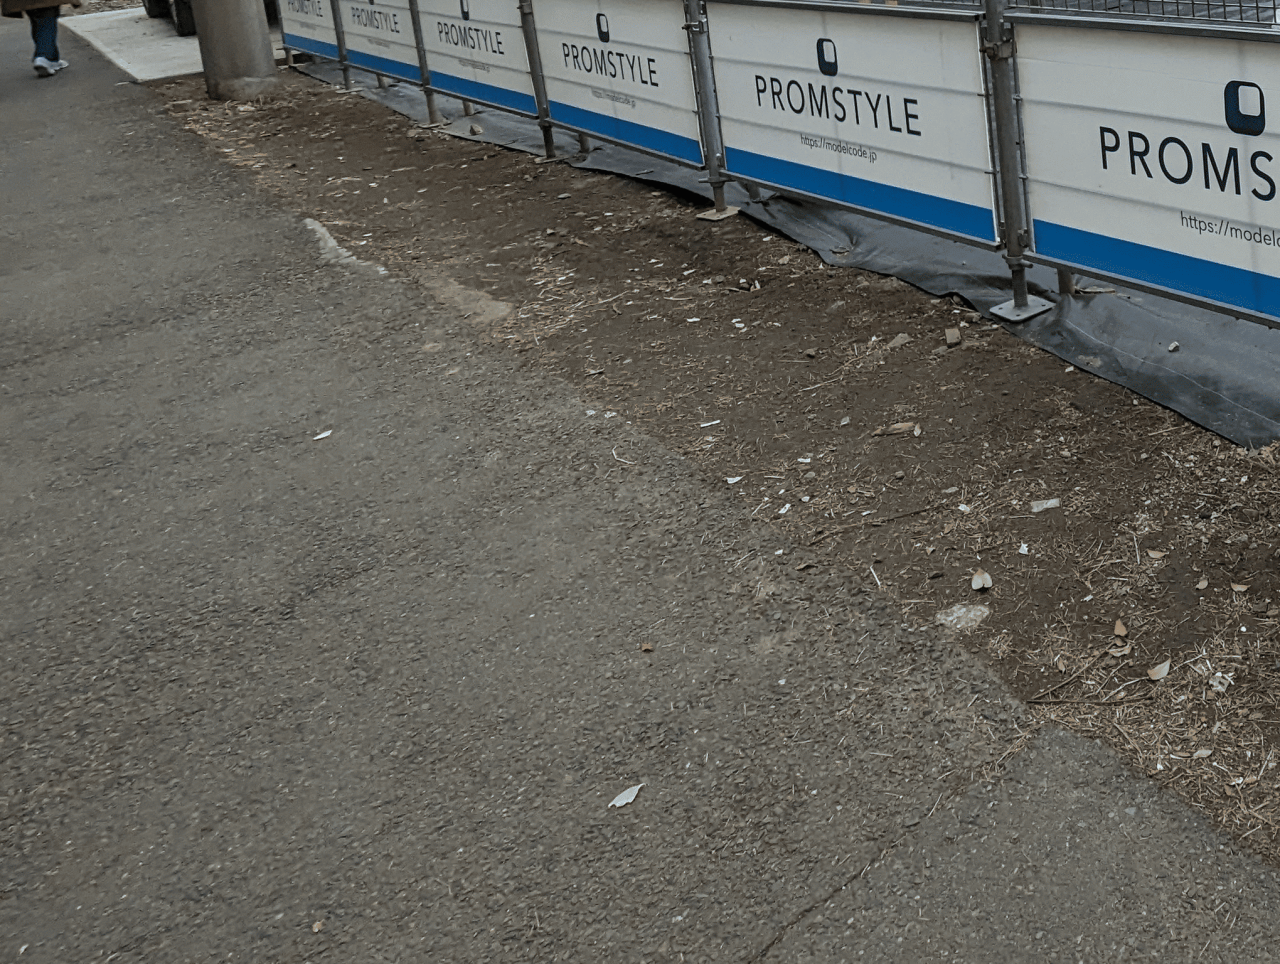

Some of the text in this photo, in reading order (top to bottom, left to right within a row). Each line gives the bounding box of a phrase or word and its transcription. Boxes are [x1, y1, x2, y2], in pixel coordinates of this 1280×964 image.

[351, 7, 400, 33] PROMSTYLE
[437, 21, 504, 55] PROMSTYLE
[562, 43, 659, 87] PROMSTYLE
[755, 74, 922, 137] PROMSTYLE
[800, 134, 877, 164] https://modelcode.jp
